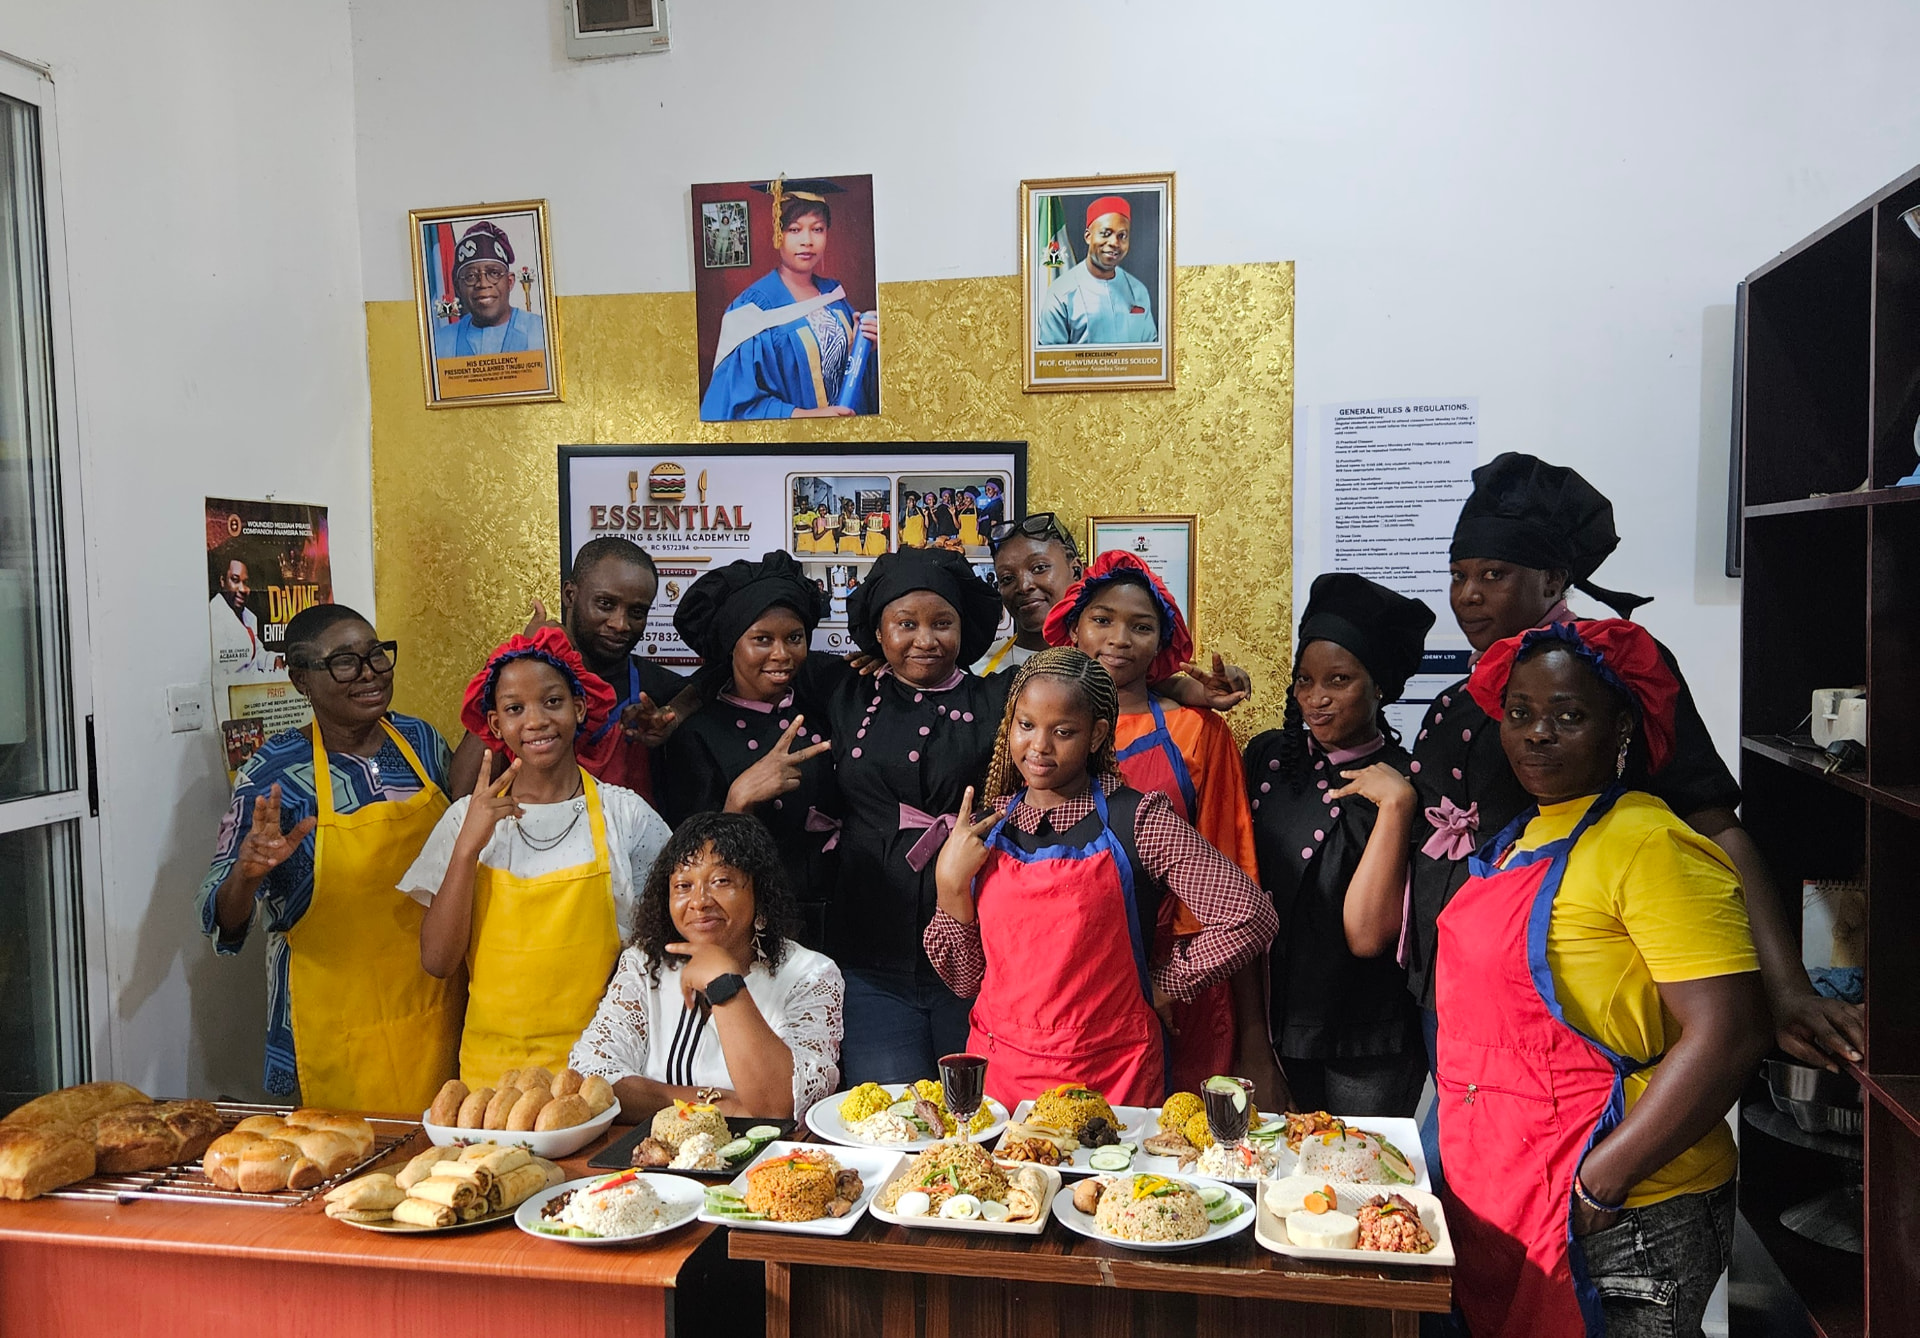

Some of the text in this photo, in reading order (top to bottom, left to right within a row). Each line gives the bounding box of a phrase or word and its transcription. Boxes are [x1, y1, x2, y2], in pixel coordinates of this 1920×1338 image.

[479, 357, 518, 366] EXCELLENCY
[444, 368, 471, 376] PRESIDENT
[1413, 404, 1469, 412] REGULATIONS.
[590, 505, 752, 530] ESSENTIAL
[267, 688, 286, 698] PRAYER
